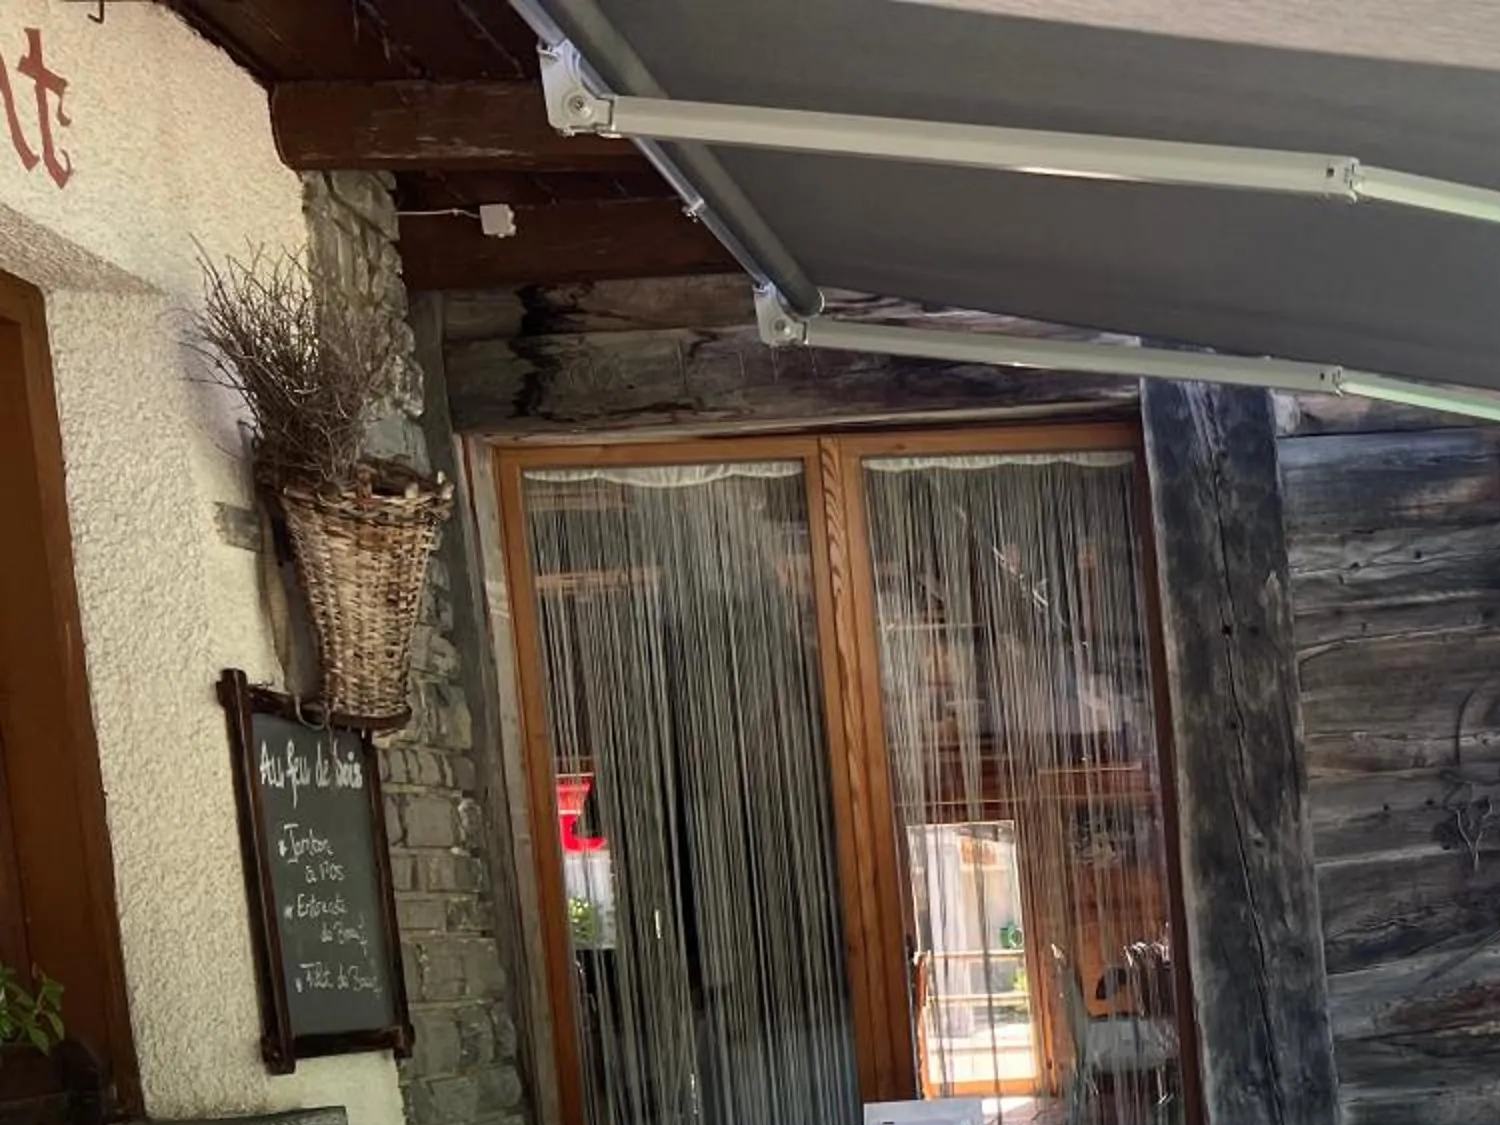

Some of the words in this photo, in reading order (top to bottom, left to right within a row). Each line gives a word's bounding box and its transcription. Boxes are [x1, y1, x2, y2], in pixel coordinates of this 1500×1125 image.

[260, 740, 285, 788] Au
[286, 738, 312, 809] feu
[315, 741, 331, 788] de
[332, 738, 363, 789] bois
